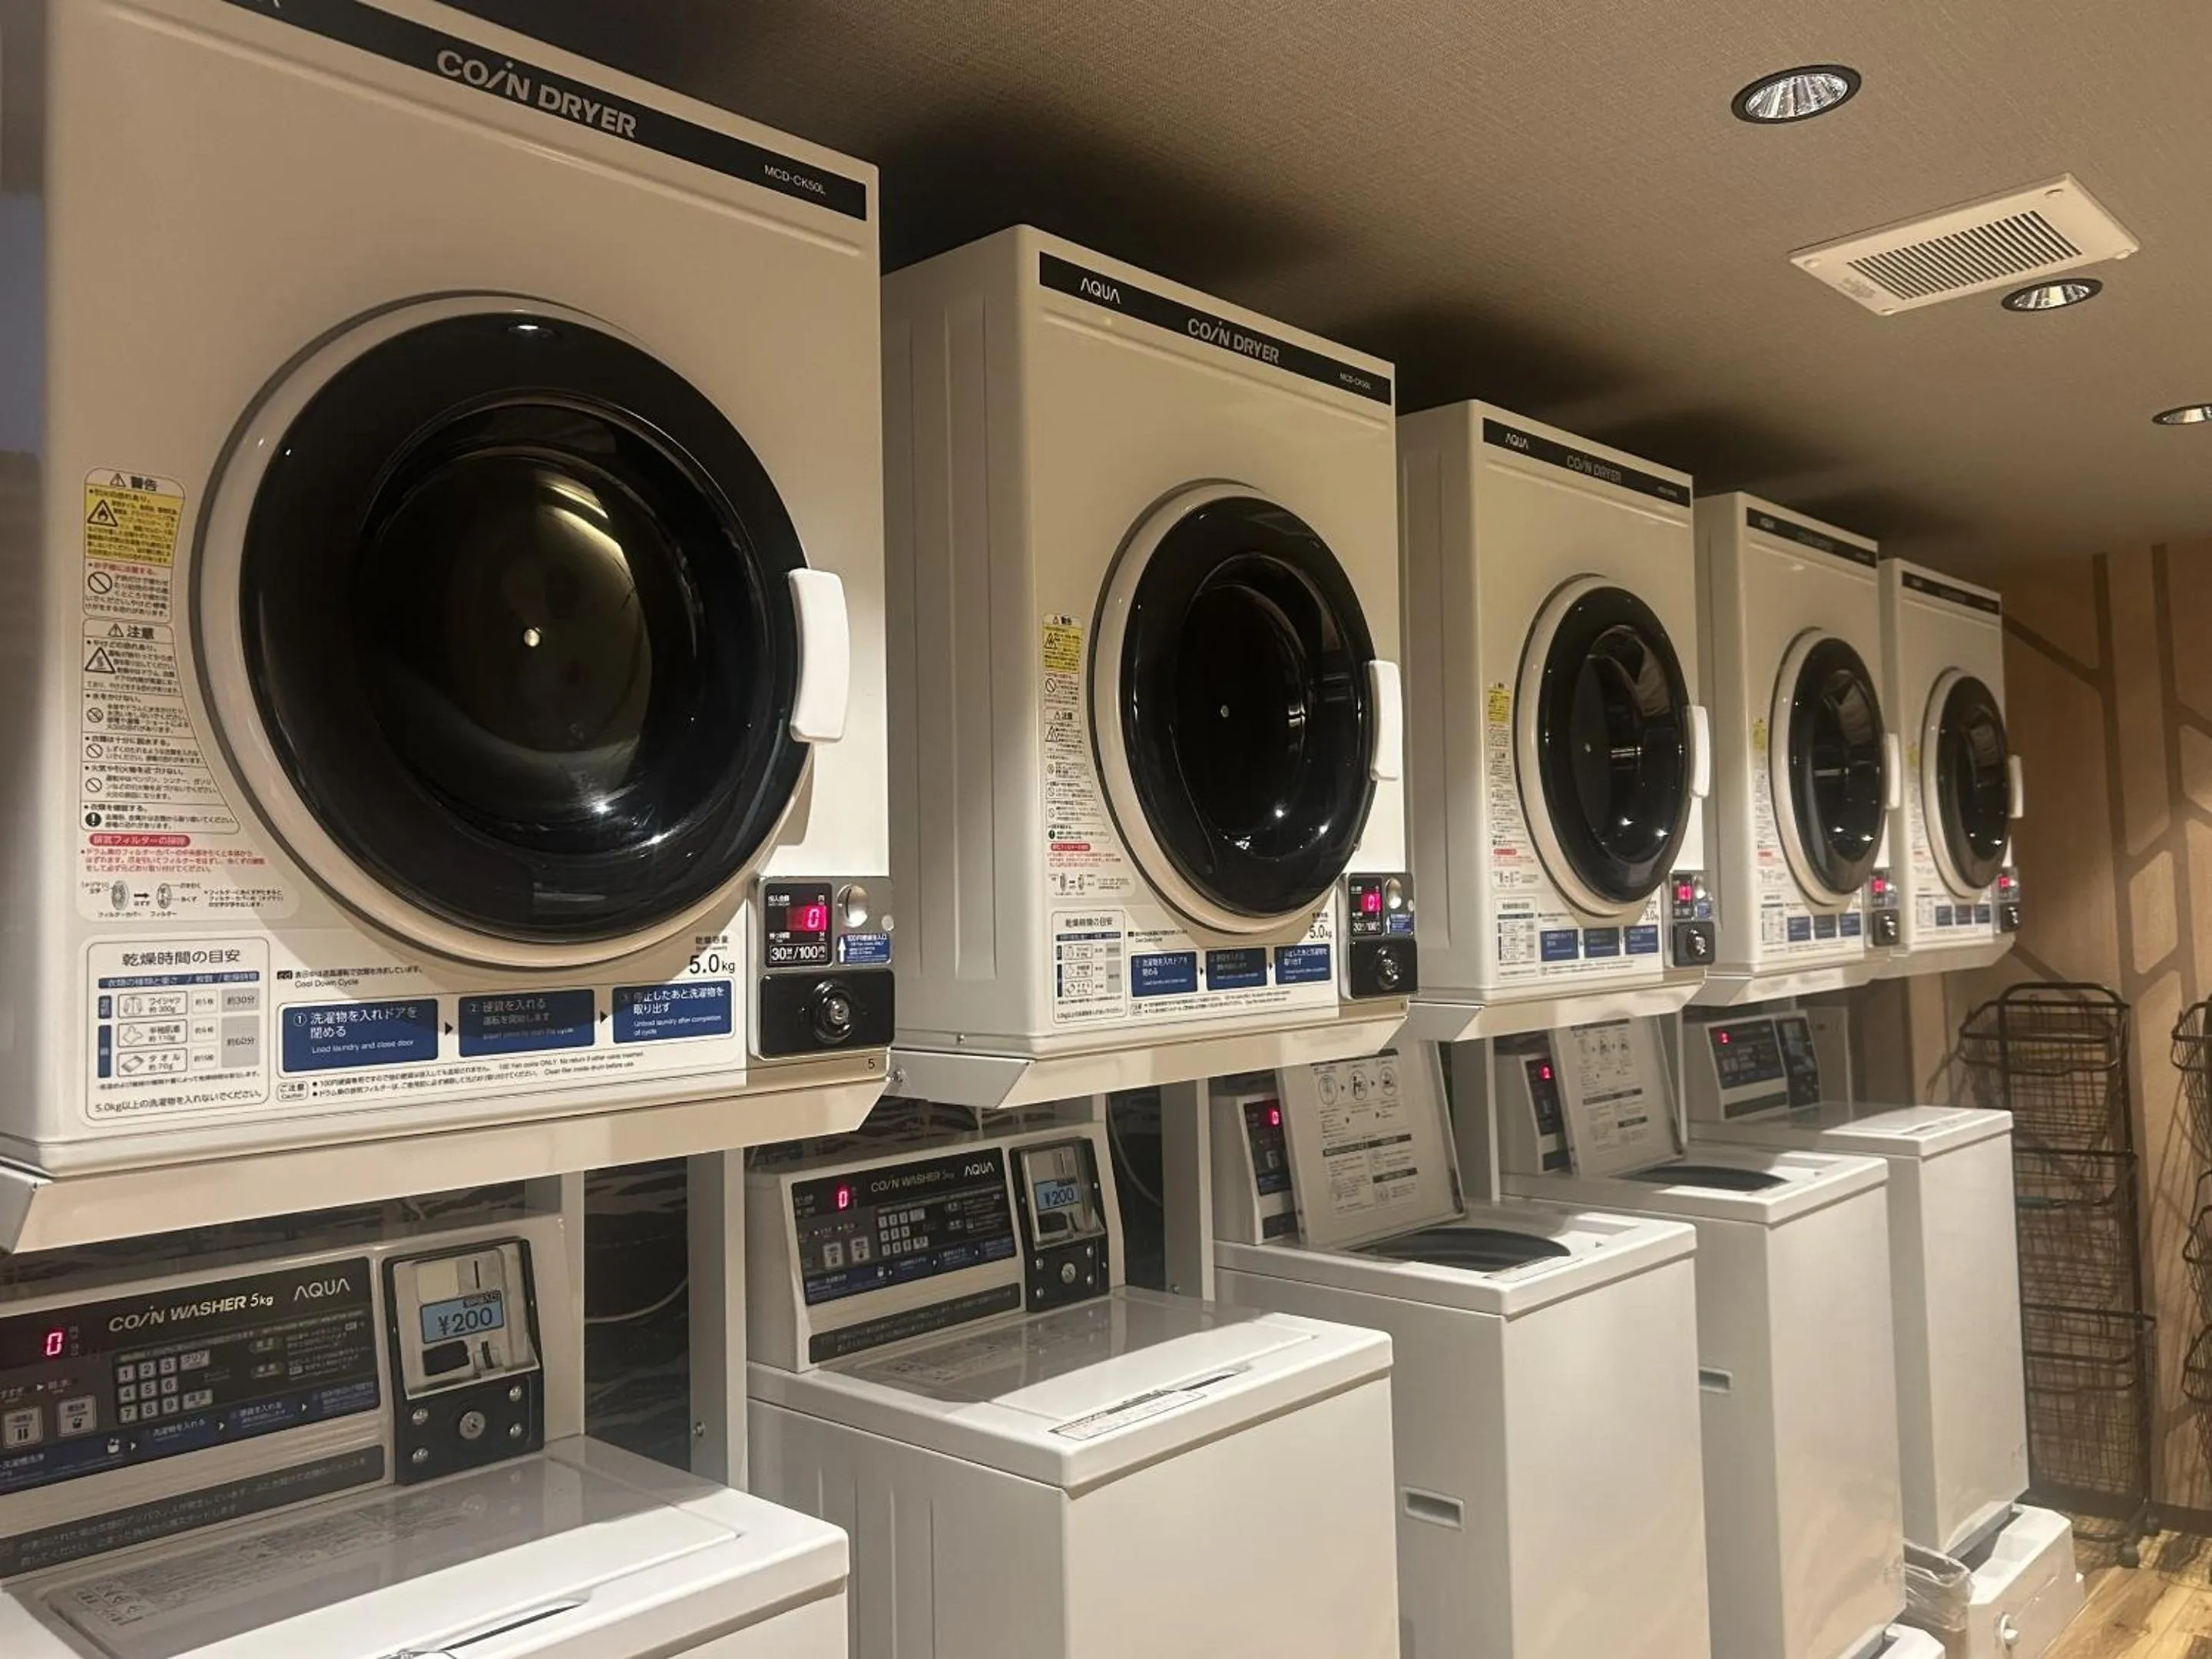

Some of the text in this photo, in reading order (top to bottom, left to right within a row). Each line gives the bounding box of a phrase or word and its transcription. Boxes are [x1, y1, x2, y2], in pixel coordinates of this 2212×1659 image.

[538, 84, 637, 139] DRYER
[1080, 276, 1121, 304] AQUA
[1233, 334, 1280, 364] DRYER
[1505, 432, 1529, 450] AQUA
[807, 908, 820, 929] 0
[122, 949, 241, 966] 乾燥時間の目安
[634, 986, 725, 1003] 停止したあと洗濯物を
[310, 1006, 419, 1025] 洗濯物を入れドアを
[633, 1002, 671, 1015] 取り出す
[310, 1026, 346, 1040] 閉める
[867, 1058, 876, 1069] 5
[964, 1161, 995, 1177] AQUA
[838, 1190, 849, 1209] 0
[293, 1277, 351, 1303] AQUA
[170, 1296, 247, 1321] WASHER
[250, 1293, 274, 1308] 5kg
[437, 1306, 493, 1336] ¥200
[45, 1331, 64, 1356] 0
[143, 1364, 151, 1375] 2
[164, 1360, 172, 1372] 3
[145, 1385, 153, 1395] 5
[165, 1381, 174, 1391] 6
[124, 1409, 132, 1419] 7
[145, 1404, 154, 1415] 8
